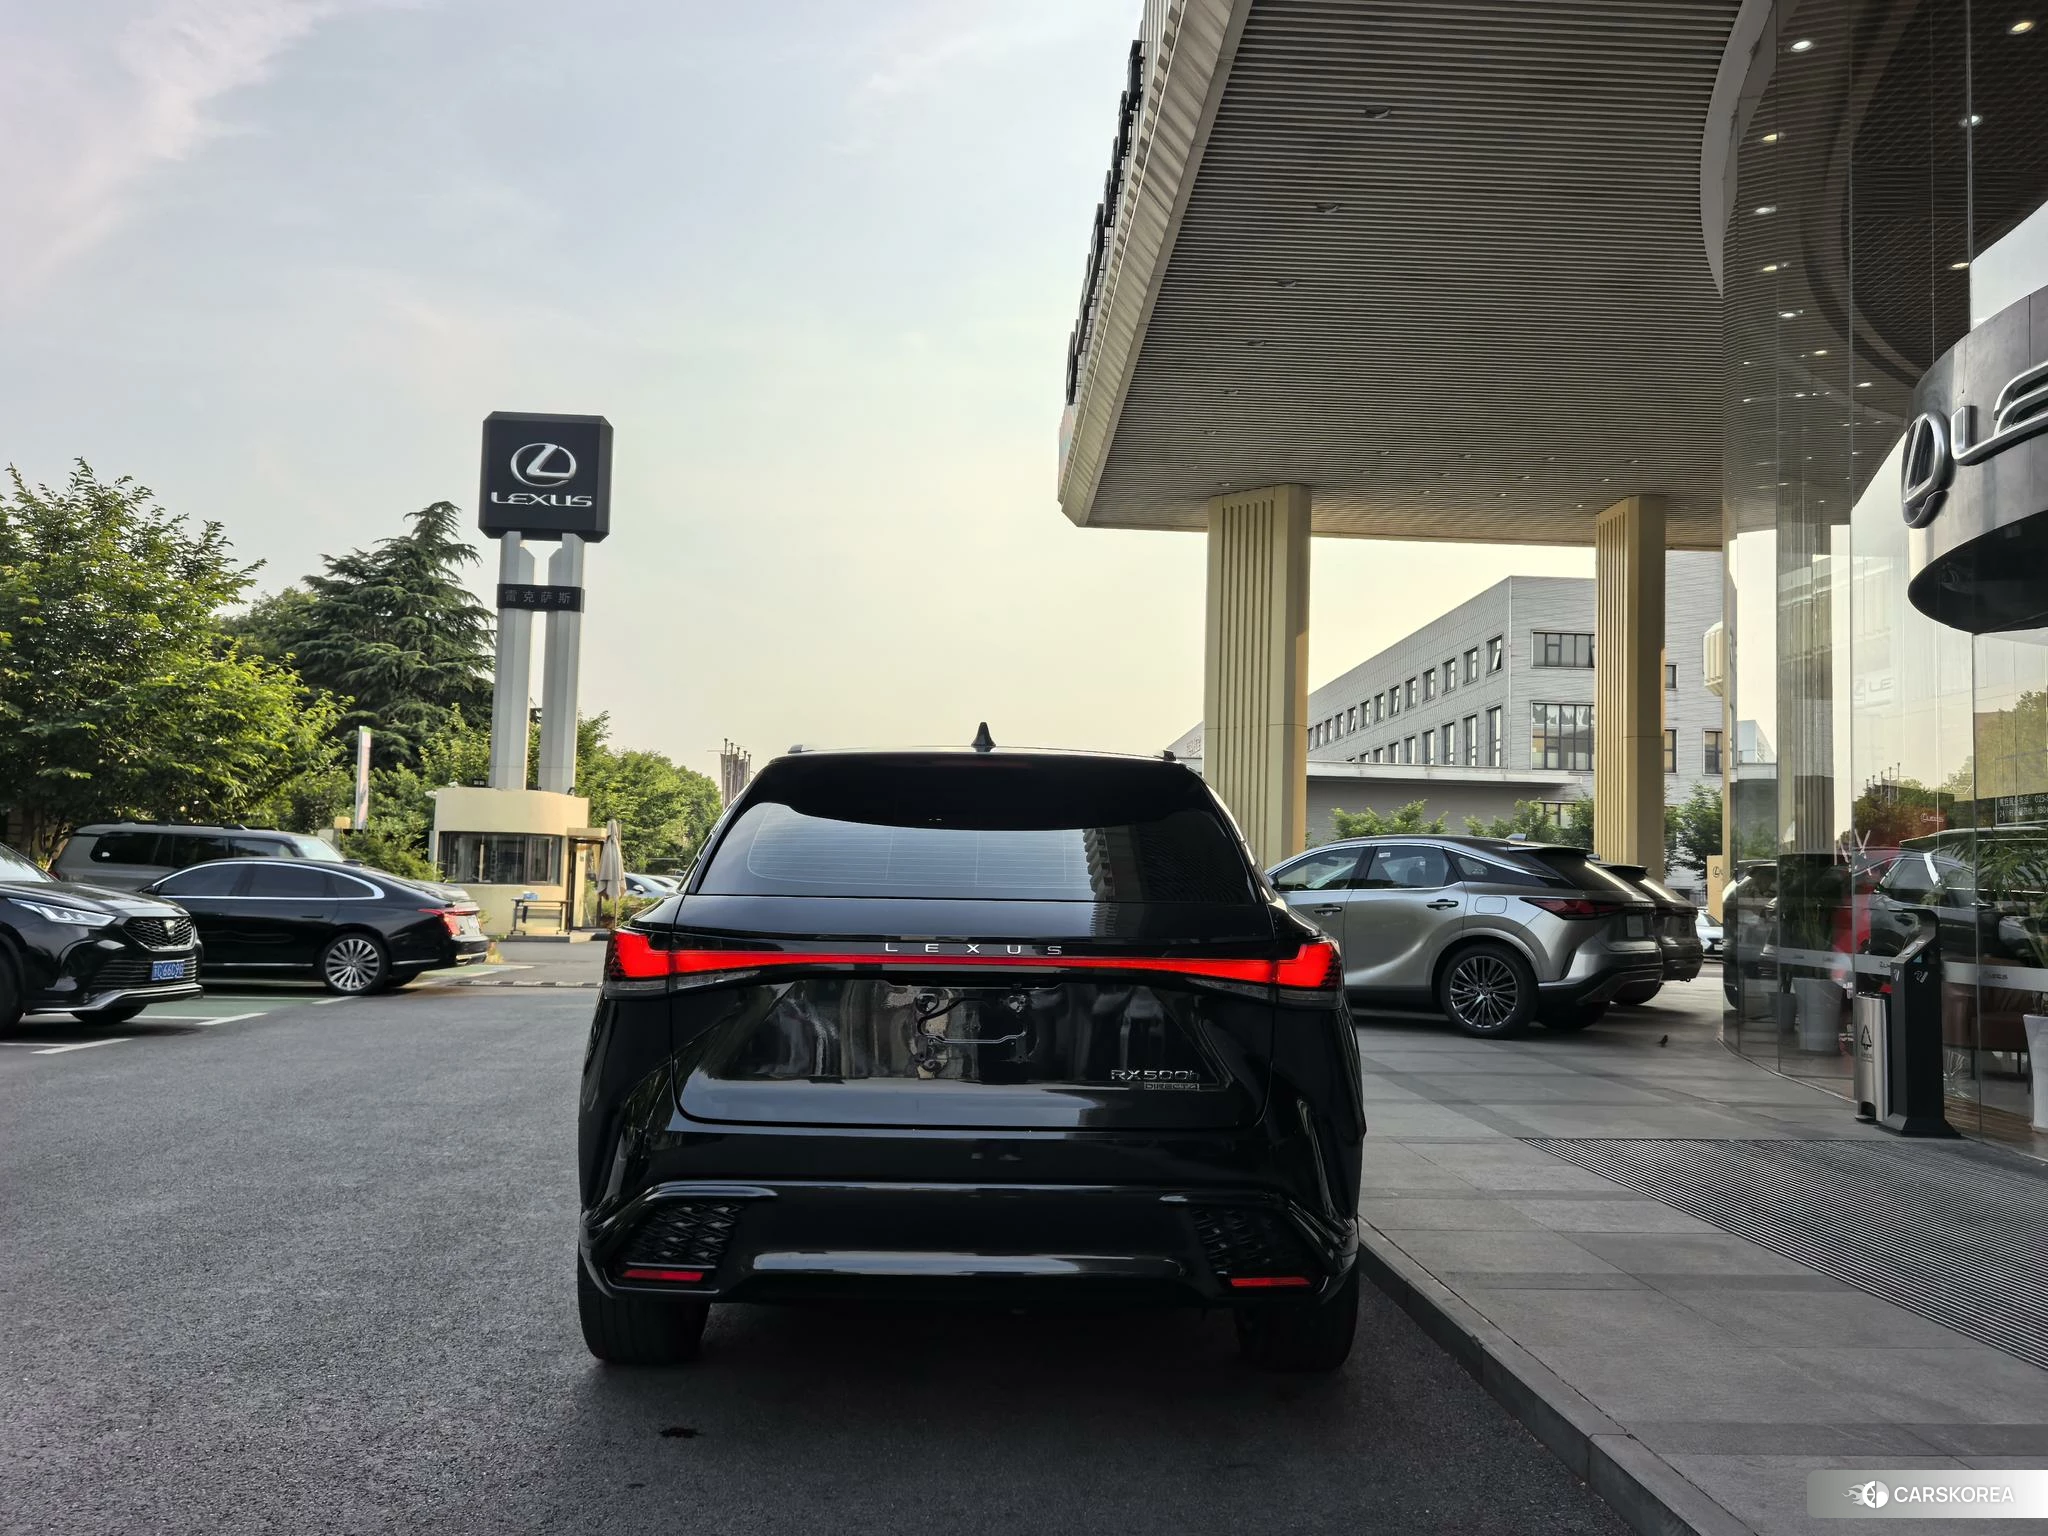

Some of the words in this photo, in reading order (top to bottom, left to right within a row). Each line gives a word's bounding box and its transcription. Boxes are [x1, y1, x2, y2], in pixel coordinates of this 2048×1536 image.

[491, 491, 592, 507] LEXUS
[505, 589, 571, 604] 雷克萨斯
[885, 943, 1062, 955] LEXUS
